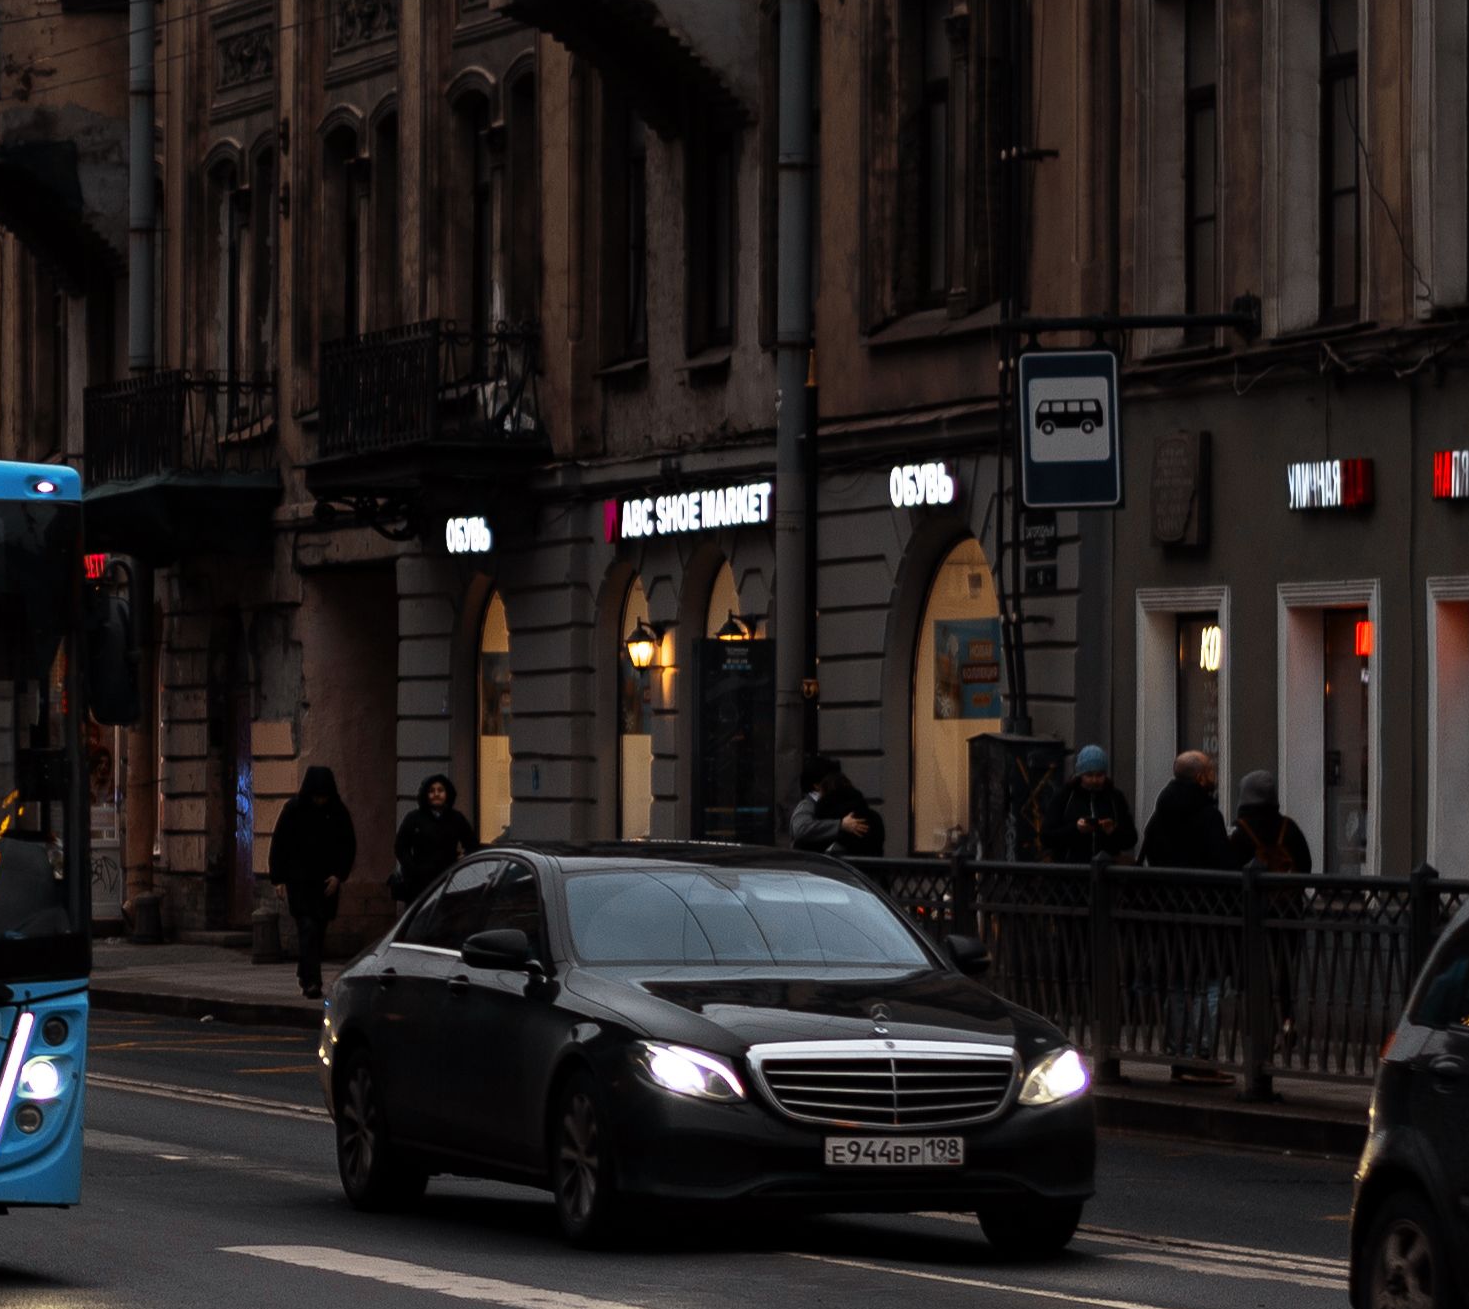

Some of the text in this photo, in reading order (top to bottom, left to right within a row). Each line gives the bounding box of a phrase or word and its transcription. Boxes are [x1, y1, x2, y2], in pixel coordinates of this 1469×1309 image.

[889, 461, 954, 508] ОБУВЬ
[621, 482, 771, 539] ABC SHOE MARKET
[446, 517, 491, 553] ОБУВЬ
[831, 1138, 959, 1164] Е944ВР 198
